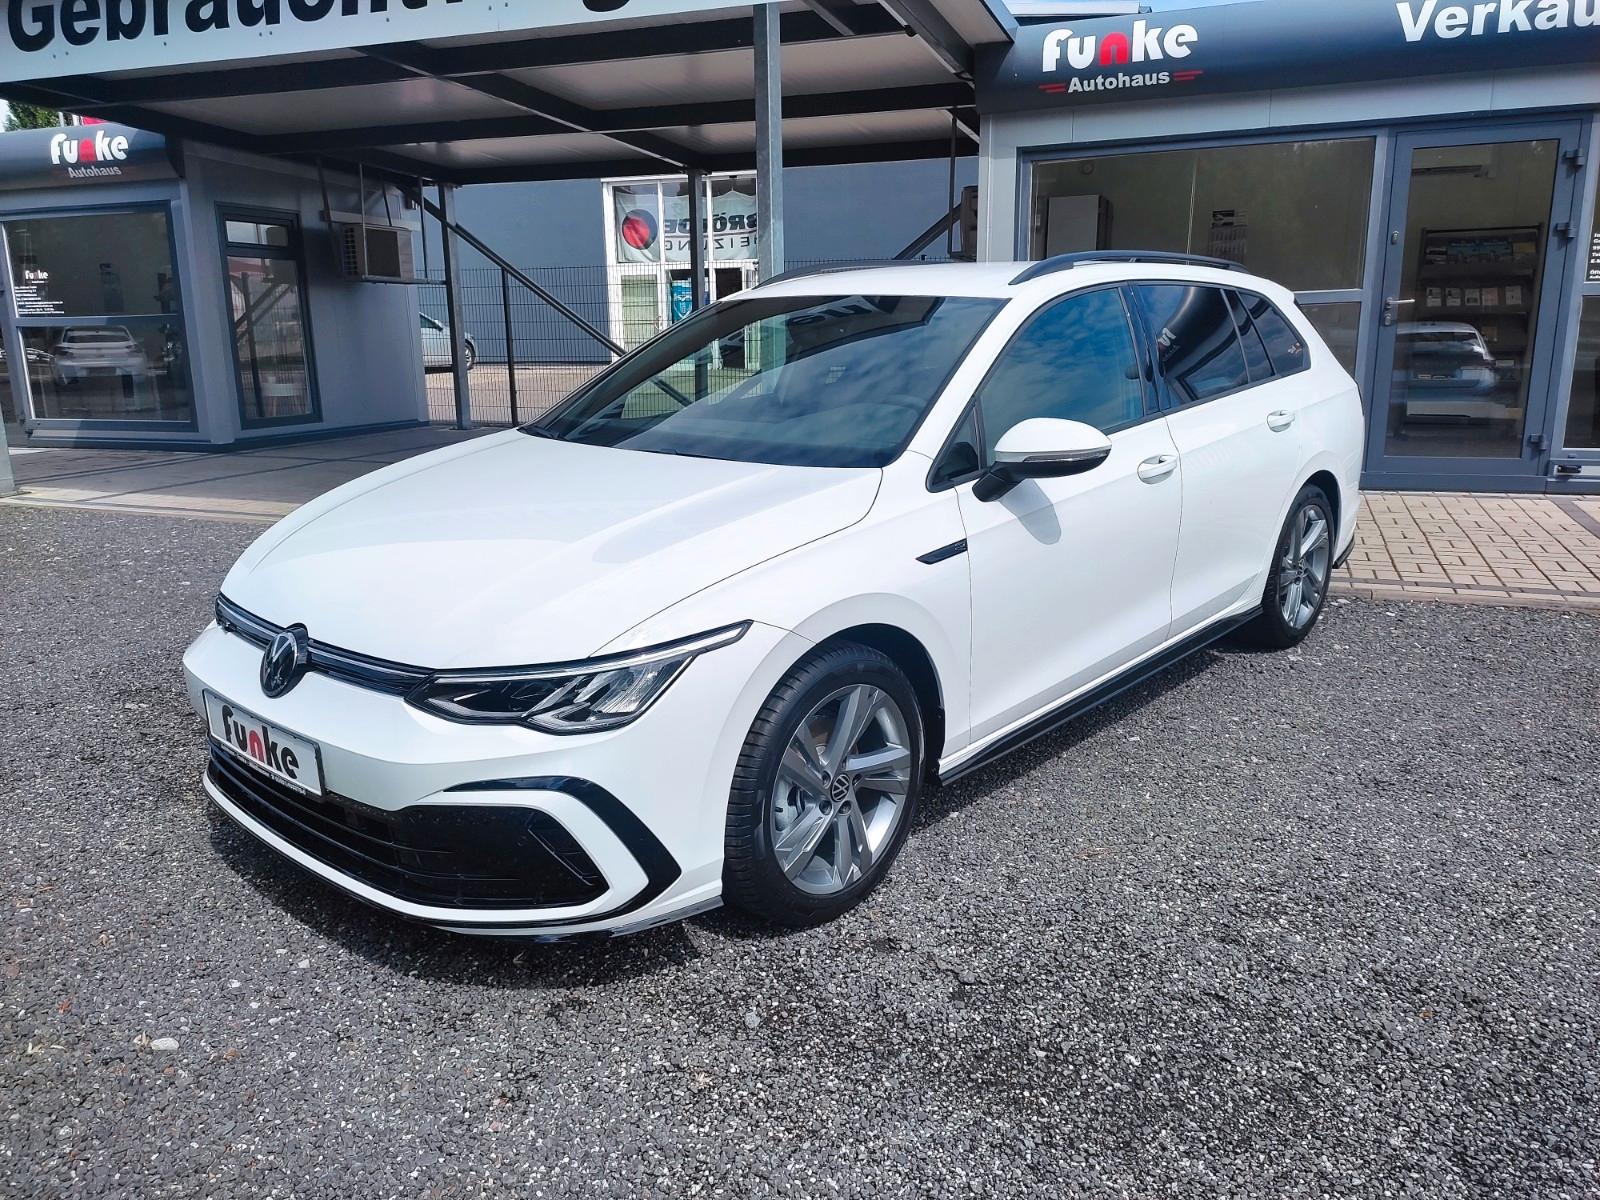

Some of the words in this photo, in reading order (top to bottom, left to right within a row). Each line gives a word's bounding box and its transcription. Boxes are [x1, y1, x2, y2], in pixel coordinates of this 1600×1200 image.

[1042, 19, 1198, 72] funke
[1067, 71, 1170, 93] Autohaus
[50, 130, 129, 164] funke
[68, 166, 122, 178] Autohaus
[221, 704, 300, 780] funke
